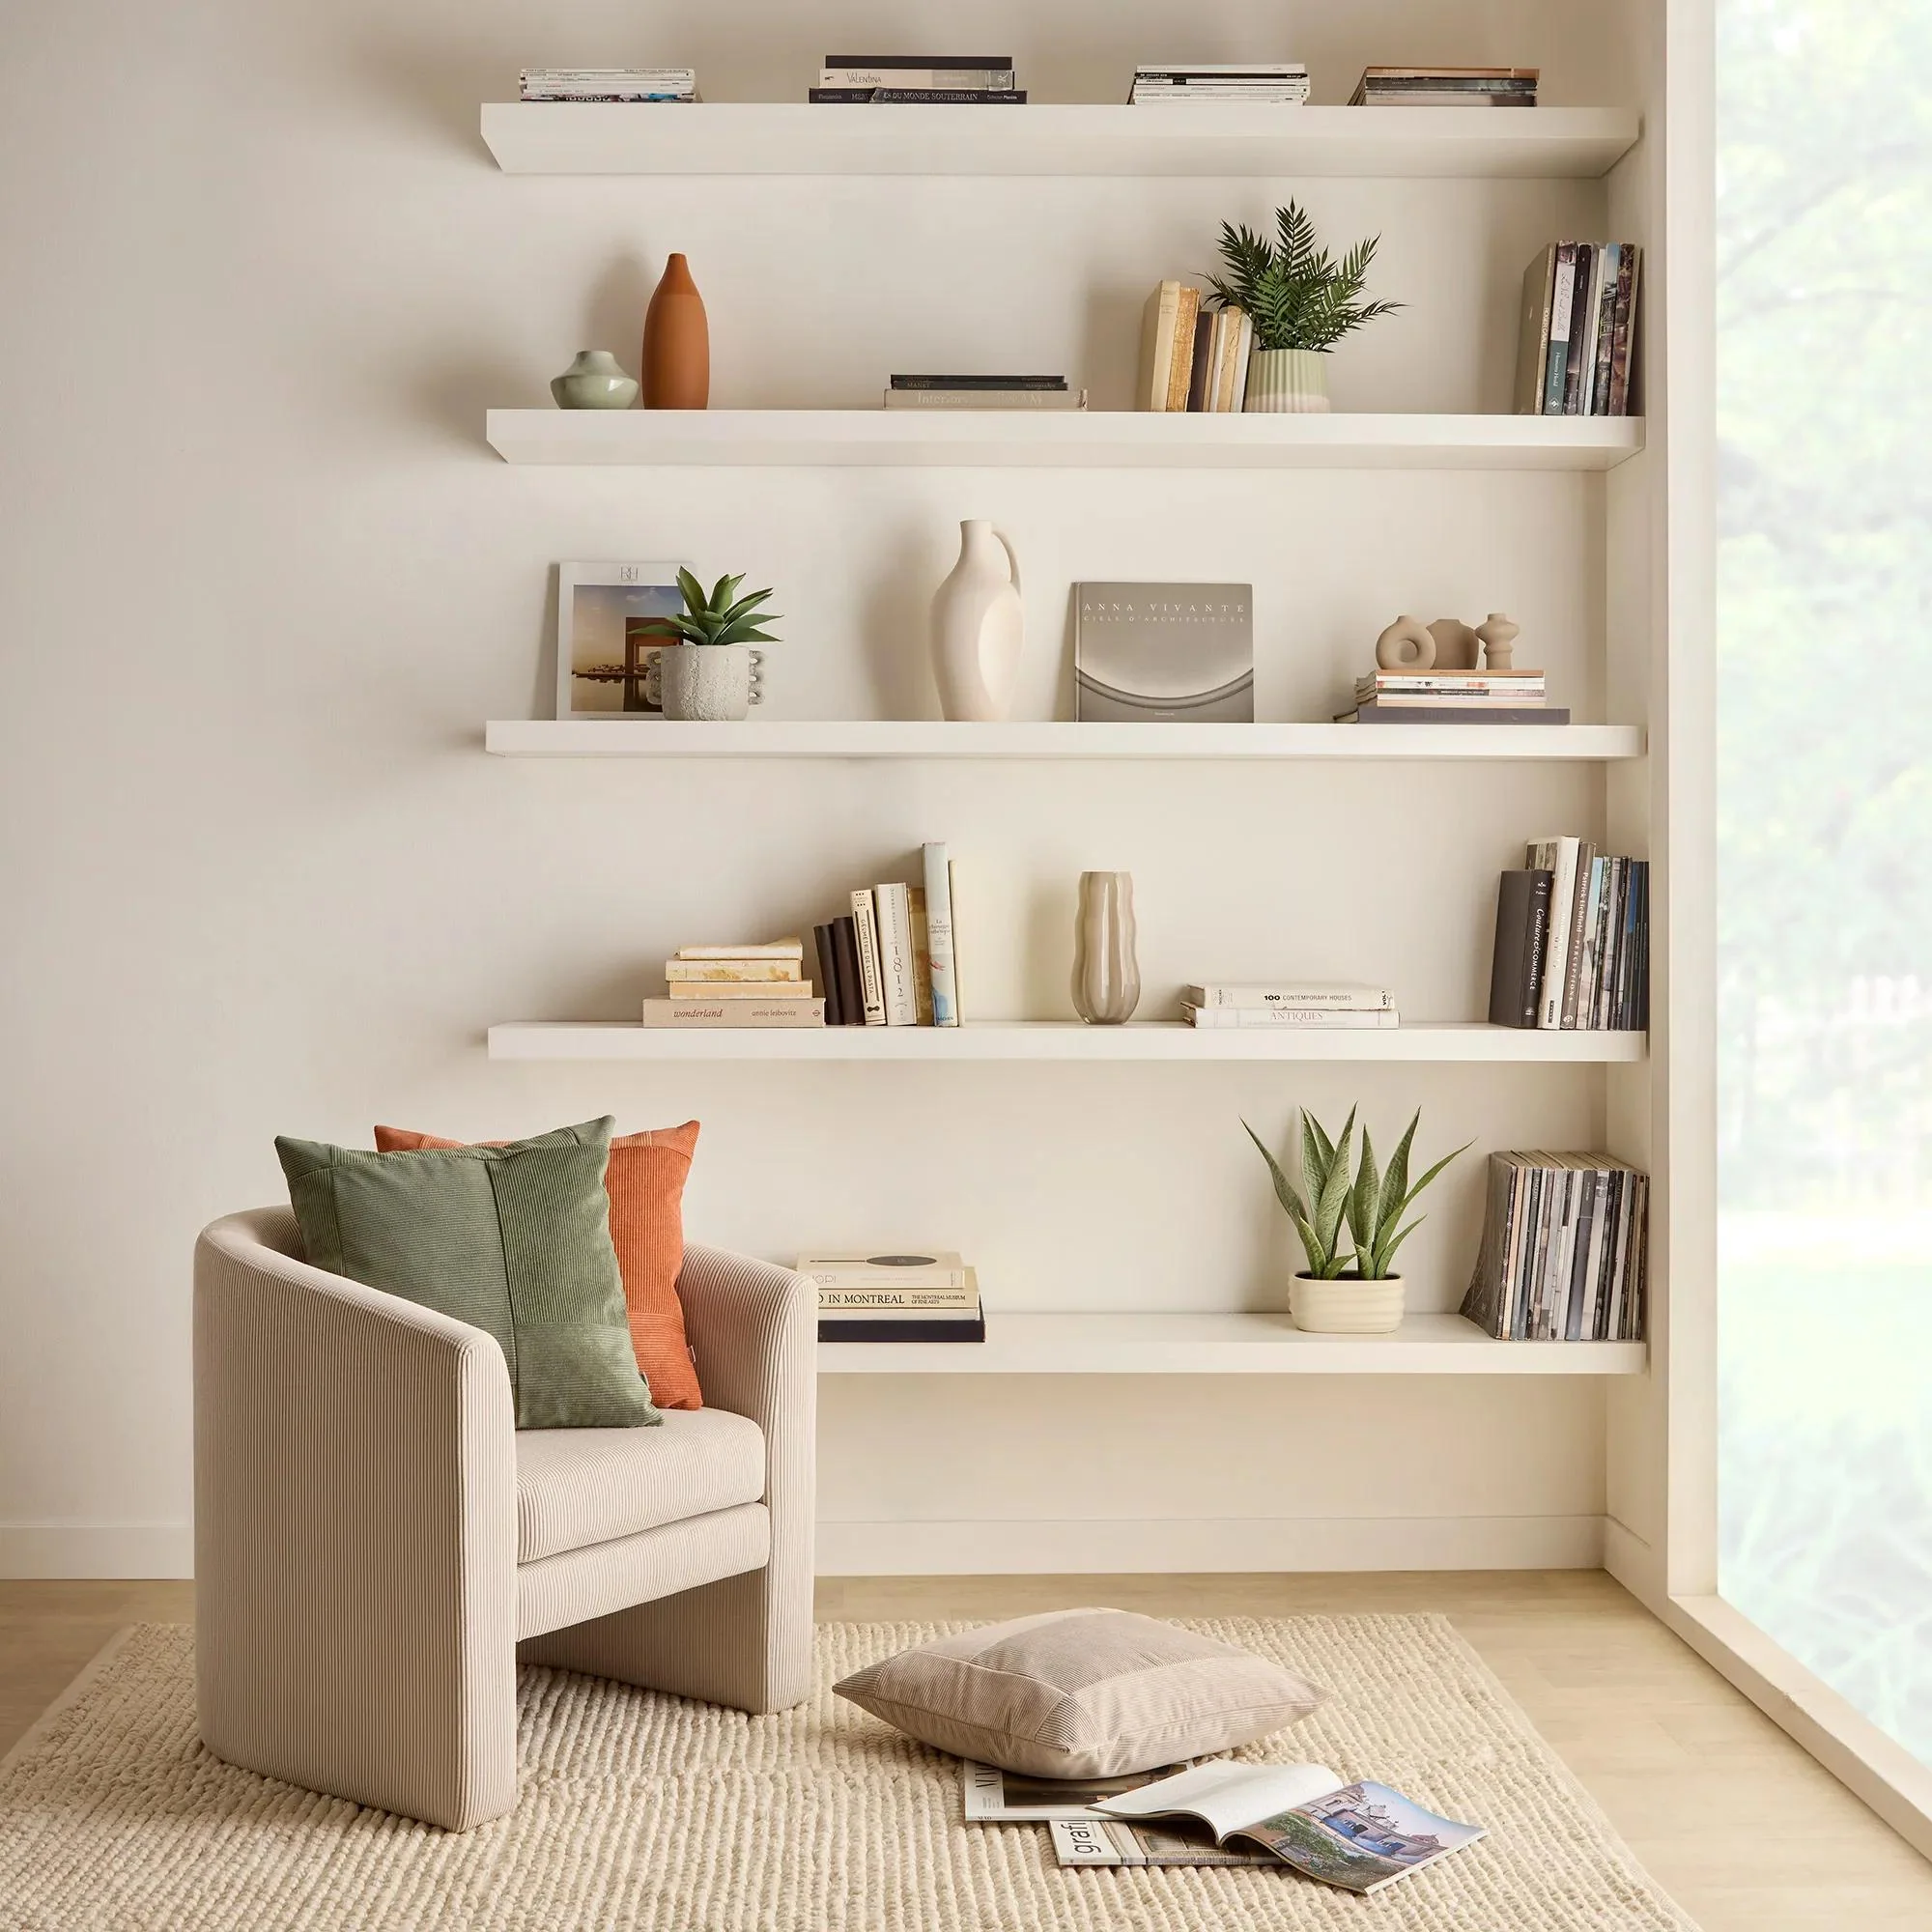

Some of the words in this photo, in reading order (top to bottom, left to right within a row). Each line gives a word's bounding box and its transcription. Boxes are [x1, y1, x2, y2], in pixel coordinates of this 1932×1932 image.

[901, 92, 930, 100] MONDE
[931, 92, 979, 100] SOUTERRAIN
[1083, 603, 1134, 611] ANNA
[1150, 604, 1244, 612] VIVANTE
[1534, 908, 1545, 941] Couture
[1529, 950, 1539, 990] COMMERCE
[673, 1009, 724, 1018] wonderland
[1271, 1011, 1323, 1021] ANTIQUES
[828, 1294, 840, 1304] IN
[844, 1294, 905, 1304] MONTREAL
